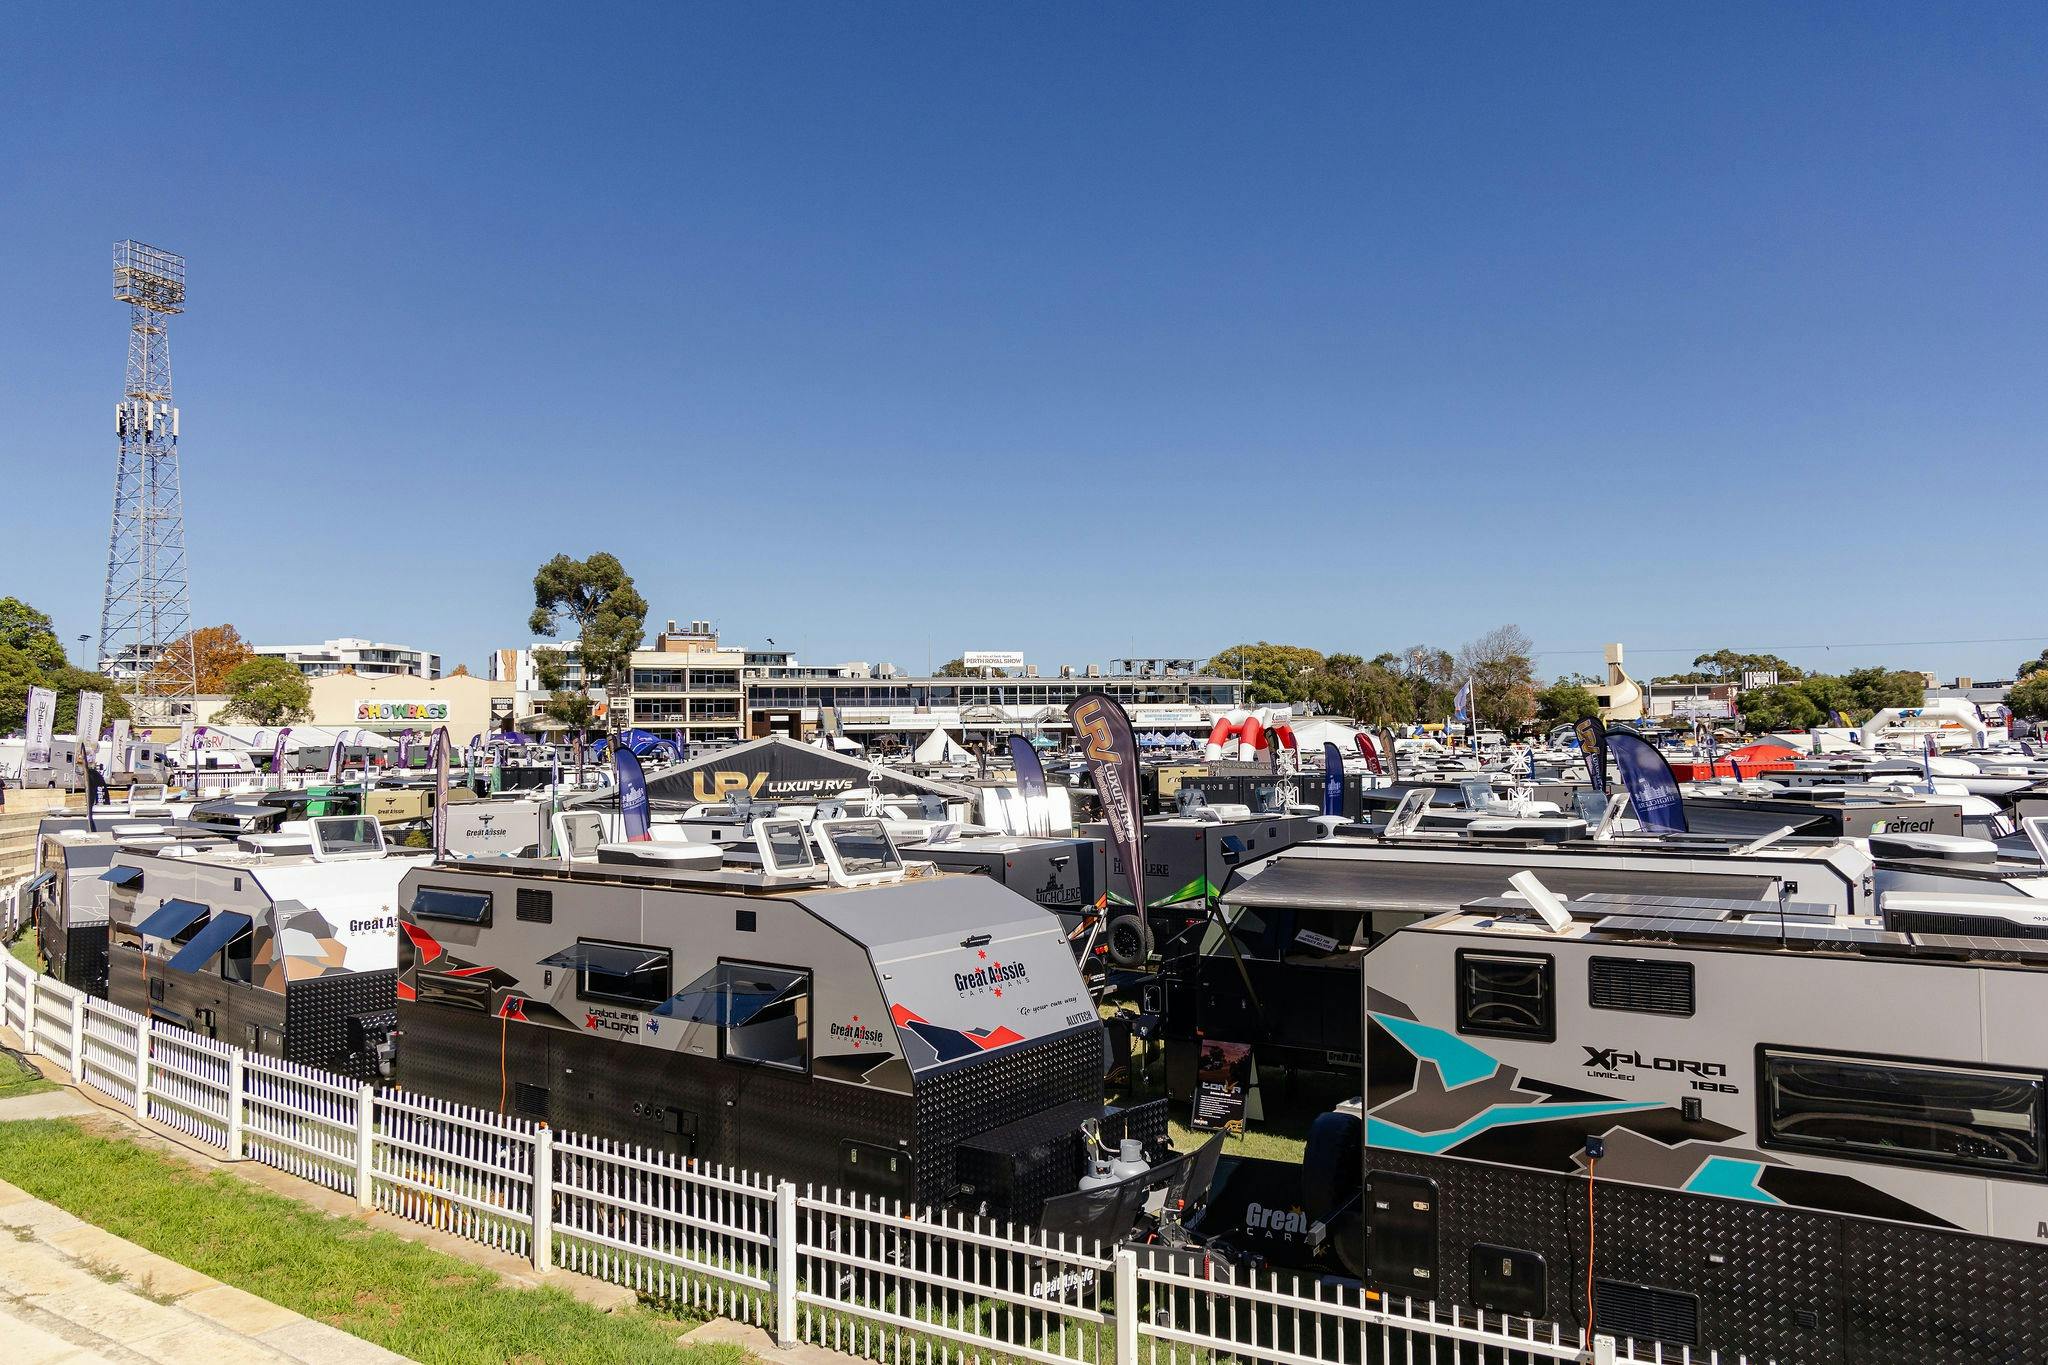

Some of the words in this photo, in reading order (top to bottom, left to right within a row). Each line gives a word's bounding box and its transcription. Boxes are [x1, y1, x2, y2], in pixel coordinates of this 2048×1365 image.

[358, 704, 447, 719] SHOWBAGS
[1094, 766, 1112, 804] Western
[1106, 806, 1126, 843] Australia
[466, 829, 484, 837] Great
[485, 827, 507, 836] Aussie
[1885, 818, 1934, 833] retreat
[1113, 862, 1169, 875] HILERE
[1036, 886, 1081, 903] HIGHCLERE
[350, 917, 383, 932] Great
[954, 969, 988, 991] Great
[988, 961, 1026, 985] Aussie
[1033, 1004, 1049, 1013] your
[621, 1012, 639, 1021] 216
[1066, 1010, 1094, 1026] ALLYTECH
[830, 1022, 853, 1037] Great
[854, 1026, 883, 1042] Aussie
[1690, 1080, 1739, 1094] 186
[1245, 1203, 1307, 1234] Great
